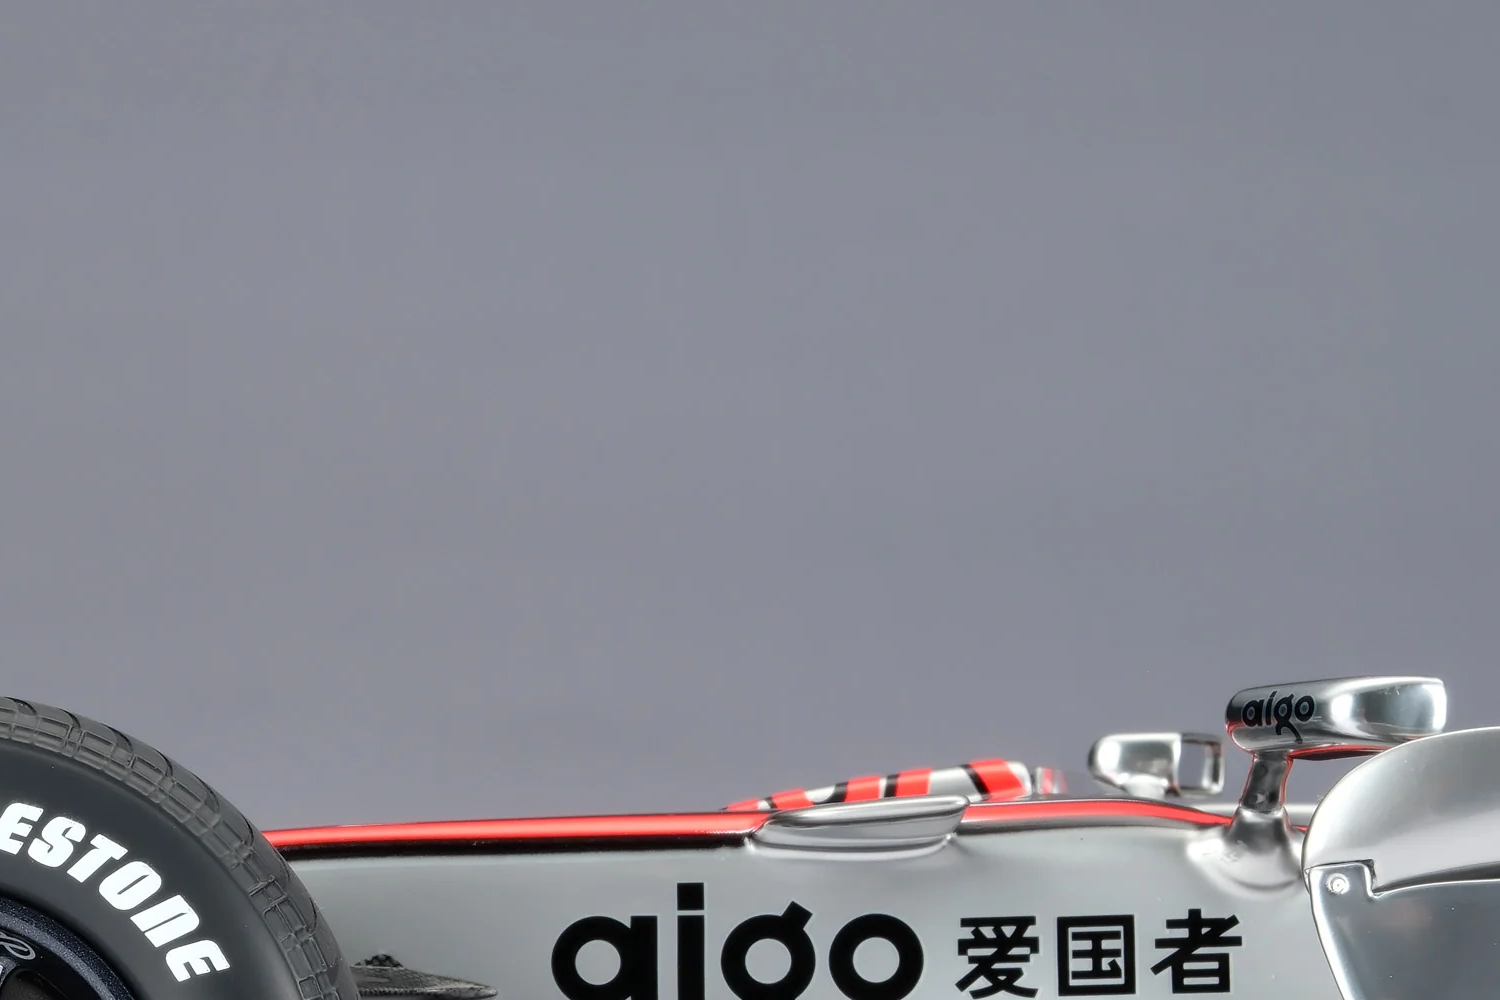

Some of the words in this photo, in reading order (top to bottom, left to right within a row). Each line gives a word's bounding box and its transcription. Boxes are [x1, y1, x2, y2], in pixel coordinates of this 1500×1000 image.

[1241, 690, 1316, 744] aigo
[955, 908, 1243, 1000] 爱国者
